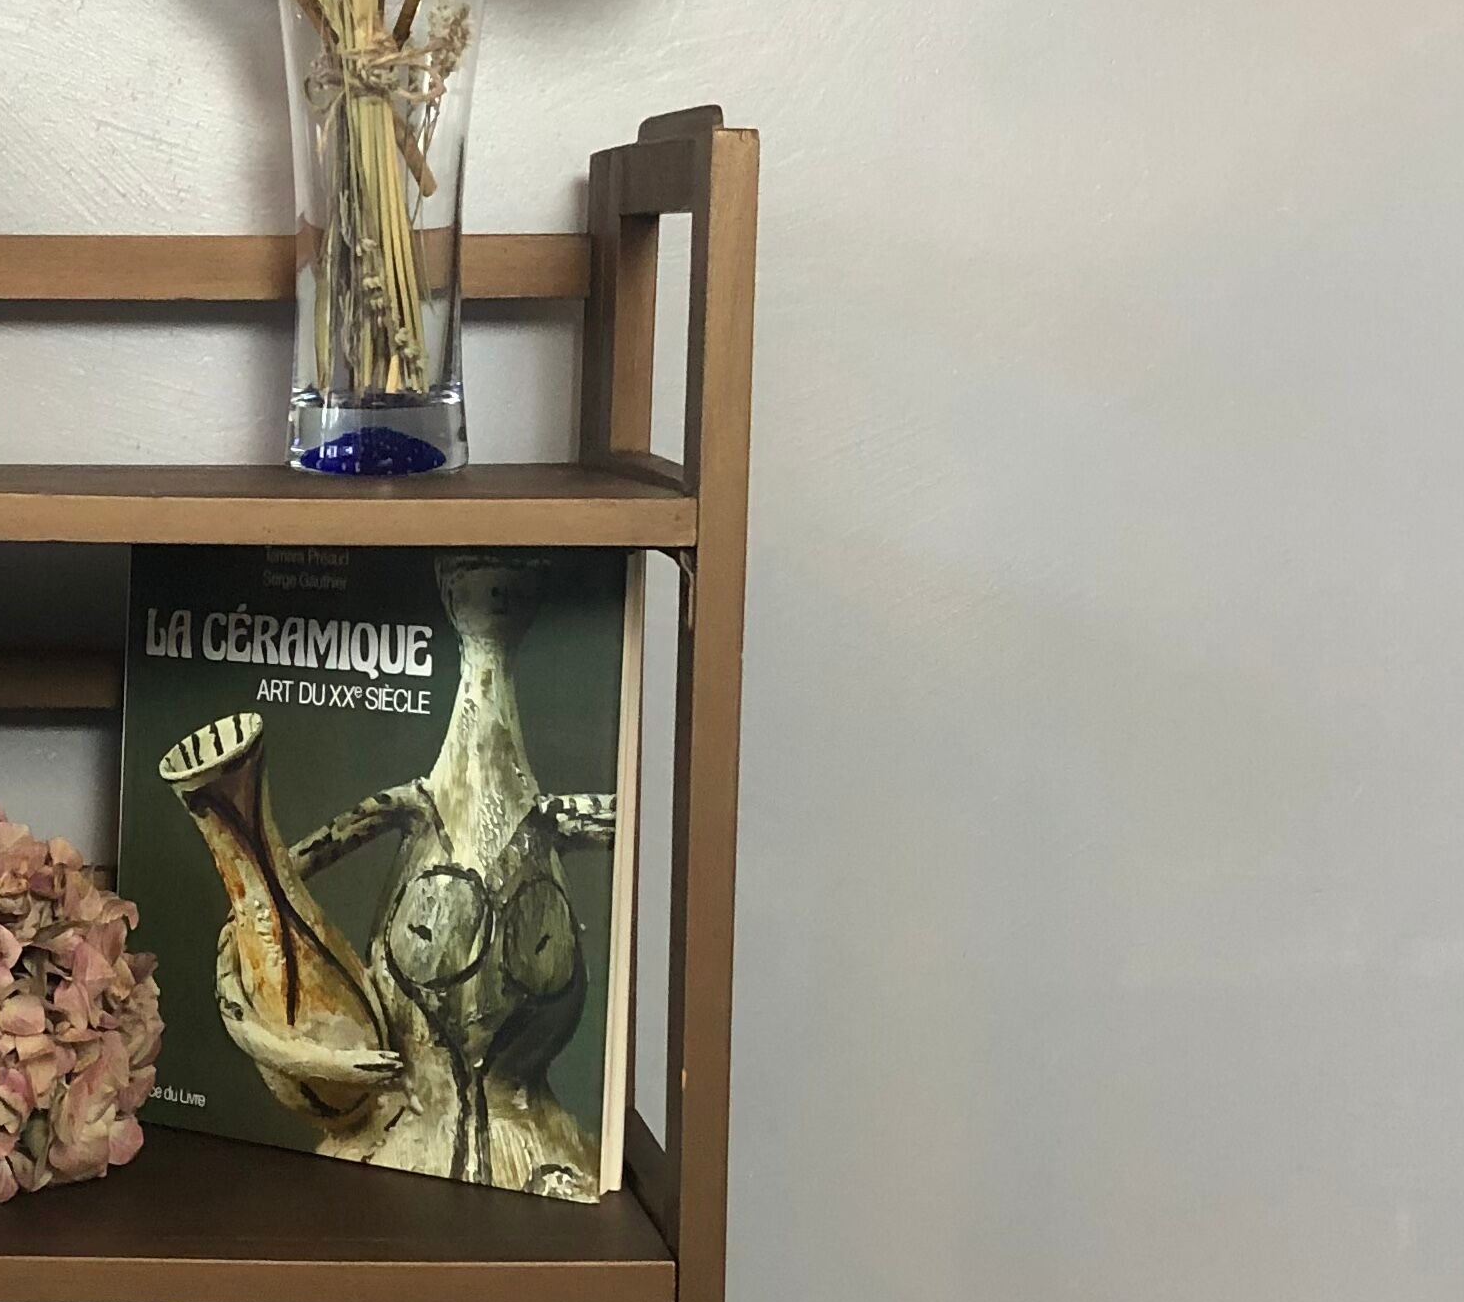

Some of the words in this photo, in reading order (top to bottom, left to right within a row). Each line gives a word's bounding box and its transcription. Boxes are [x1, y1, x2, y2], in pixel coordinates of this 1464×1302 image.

[146, 608, 193, 659] LA
[202, 603, 433, 680] CÉRAMIQUE
[256, 679, 294, 703] ART
[299, 681, 326, 706] DU
[329, 684, 363, 708] XXe
[365, 683, 431, 714] SIÈCLE
[164, 1085, 178, 1102] du
[180, 1089, 206, 1107] Livre
